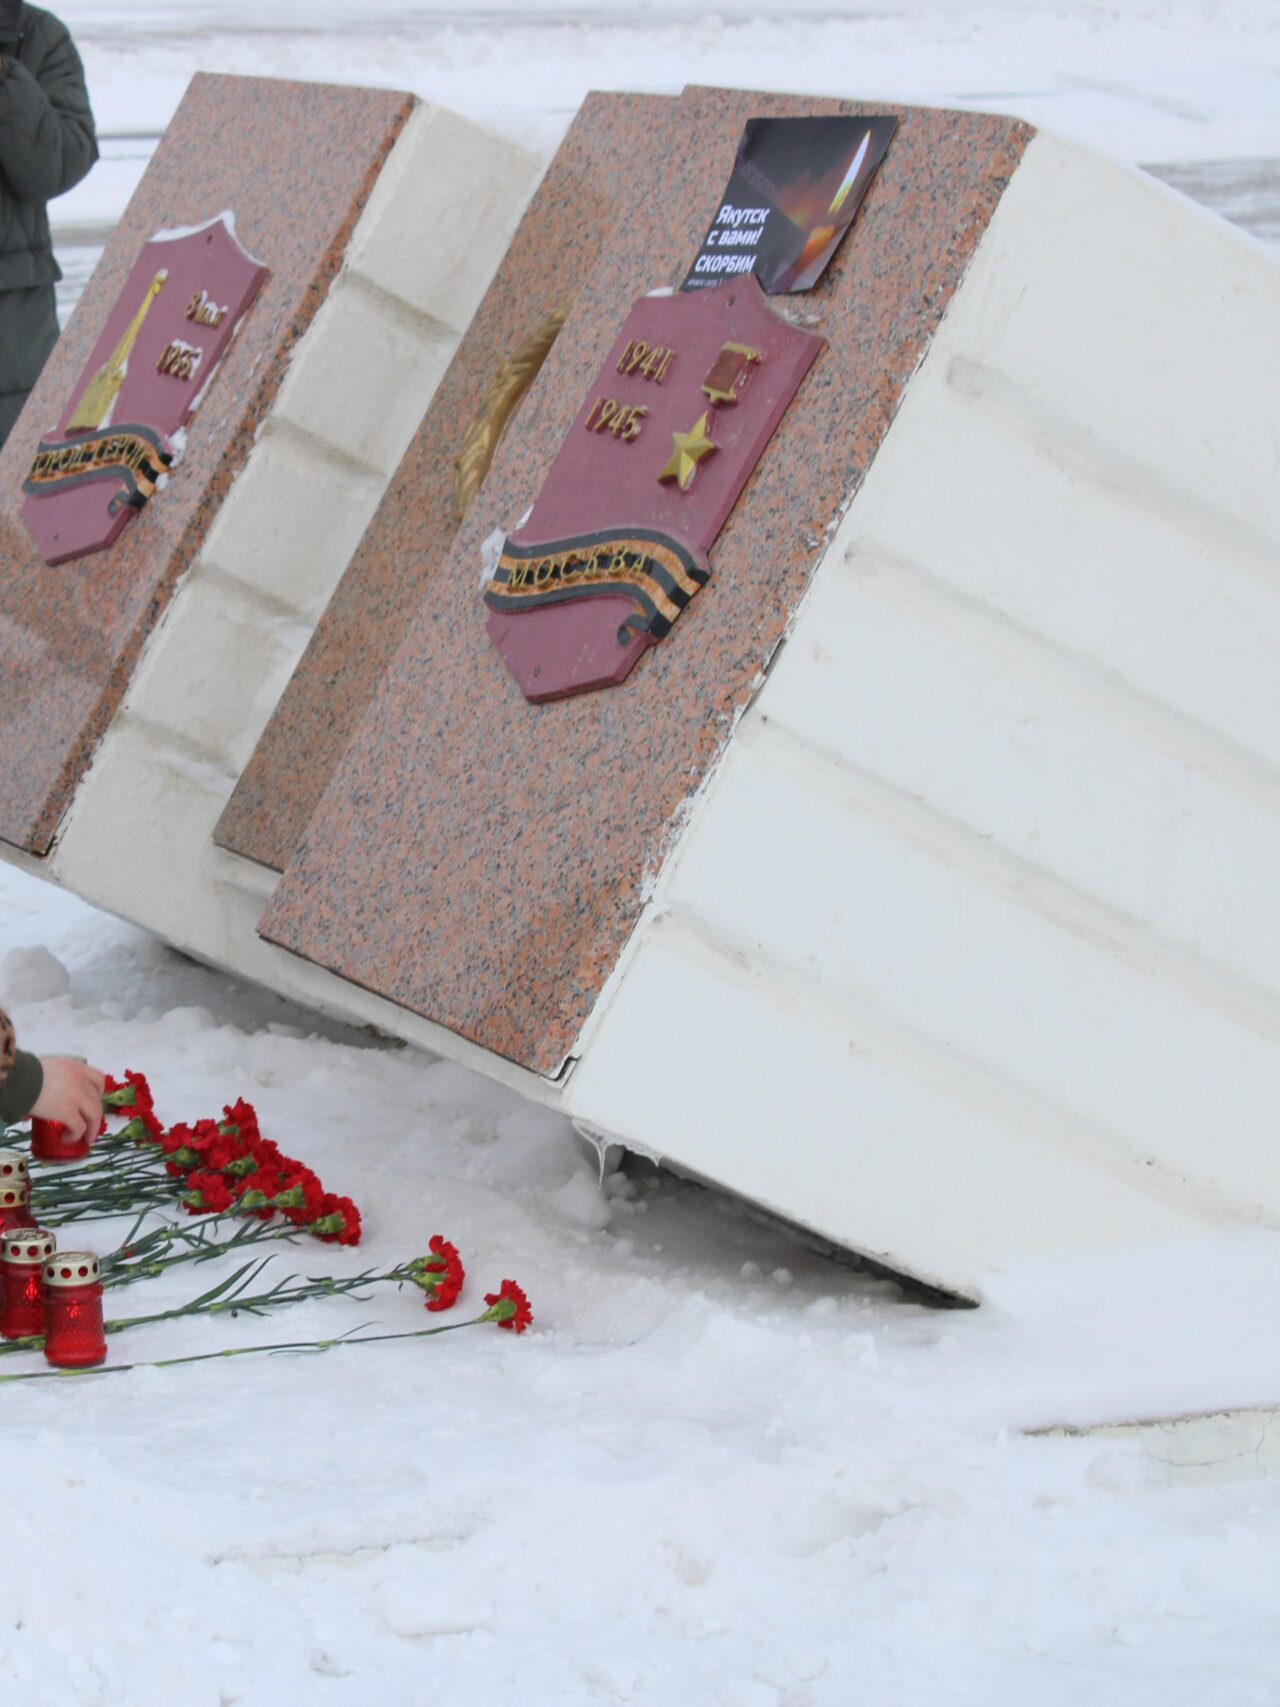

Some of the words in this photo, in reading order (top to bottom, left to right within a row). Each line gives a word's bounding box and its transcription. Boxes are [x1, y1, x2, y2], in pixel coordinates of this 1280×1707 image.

[716, 205, 770, 228] Якутск
[707, 230, 718, 246] с
[718, 227, 763, 246] вами!
[695, 254, 757, 273] СКОРБИМ
[616, 339, 673, 384] 1941
[584, 397, 648, 443] 1945
[506, 547, 650, 588] МОСКВА
